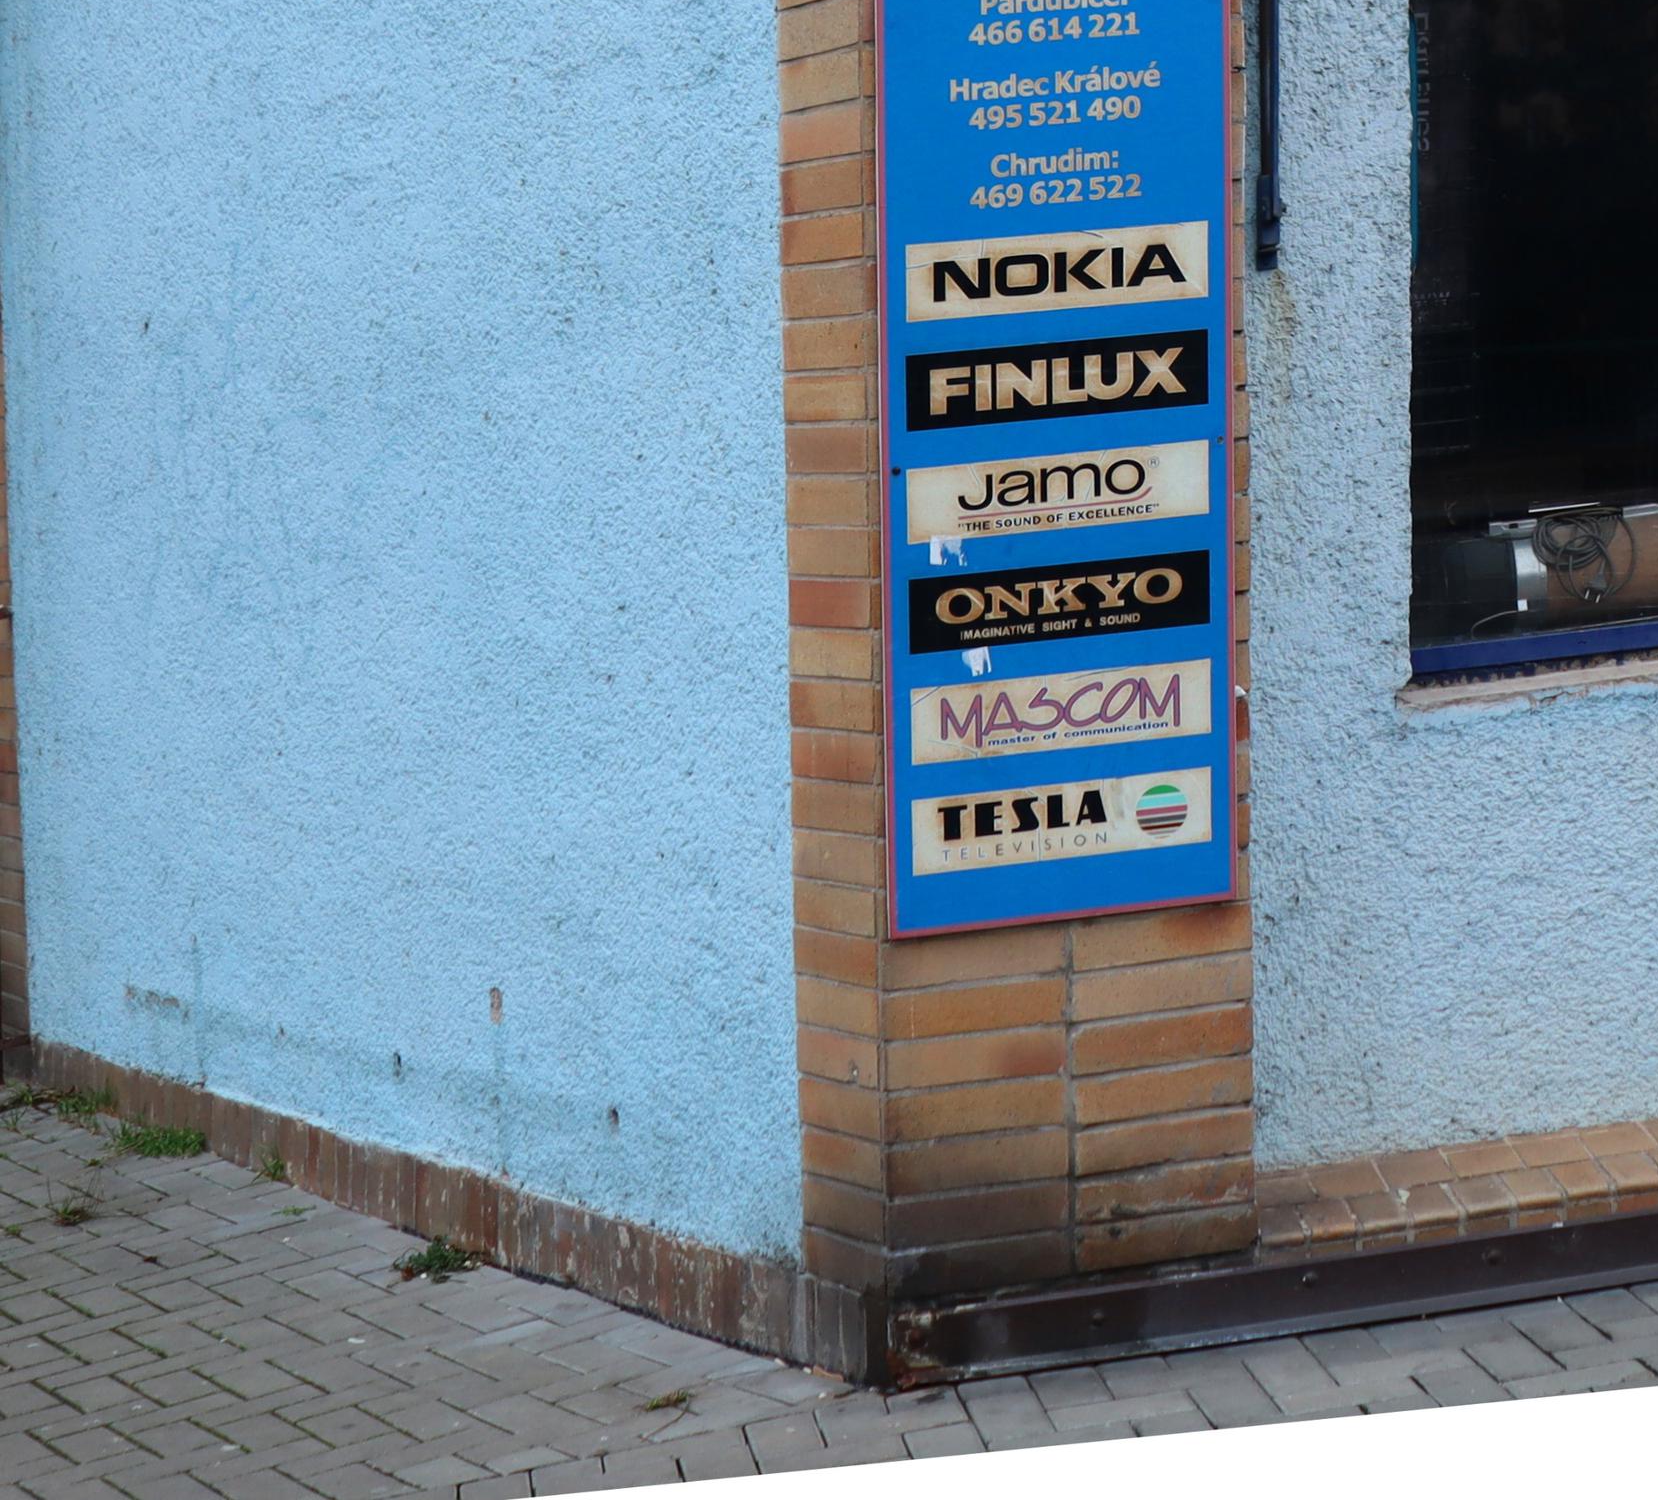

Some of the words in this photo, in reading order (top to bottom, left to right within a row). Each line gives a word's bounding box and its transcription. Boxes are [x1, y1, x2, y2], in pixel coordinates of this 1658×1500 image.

[968, 19, 1022, 46] 466
[1028, 15, 1082, 42] 614
[1088, 12, 1140, 38] 221
[949, 71, 1050, 102] Hradec
[1054, 61, 1161, 95] Králové
[969, 102, 1022, 130] 495
[1029, 99, 1081, 125] 521
[1087, 95, 1141, 121] 490
[990, 148, 1119, 178] Chrudim:
[970, 181, 1023, 209] 469
[1029, 178, 1083, 205] 622
[1088, 174, 1142, 200] 522
[933, 243, 1186, 303] NOKIA
[929, 347, 1187, 416] FINLUX
[995, 515, 1041, 528] SOUND
[1046, 513, 1064, 524] OF
[935, 567, 1183, 624] ONKYO
[960, 622, 1036, 641] IMAGINATIVE
[1042, 618, 1078, 633] SIGHT
[1084, 617, 1093, 628] &
[1099, 612, 1141, 627] SOUND
[940, 673, 1180, 748] MASCOM
[987, 735, 1041, 747] master
[1043, 731, 1057, 740] of
[1064, 720, 1169, 739] communication
[937, 790, 1107, 842] TESLA
[941, 831, 1109, 863] TELEVISION
